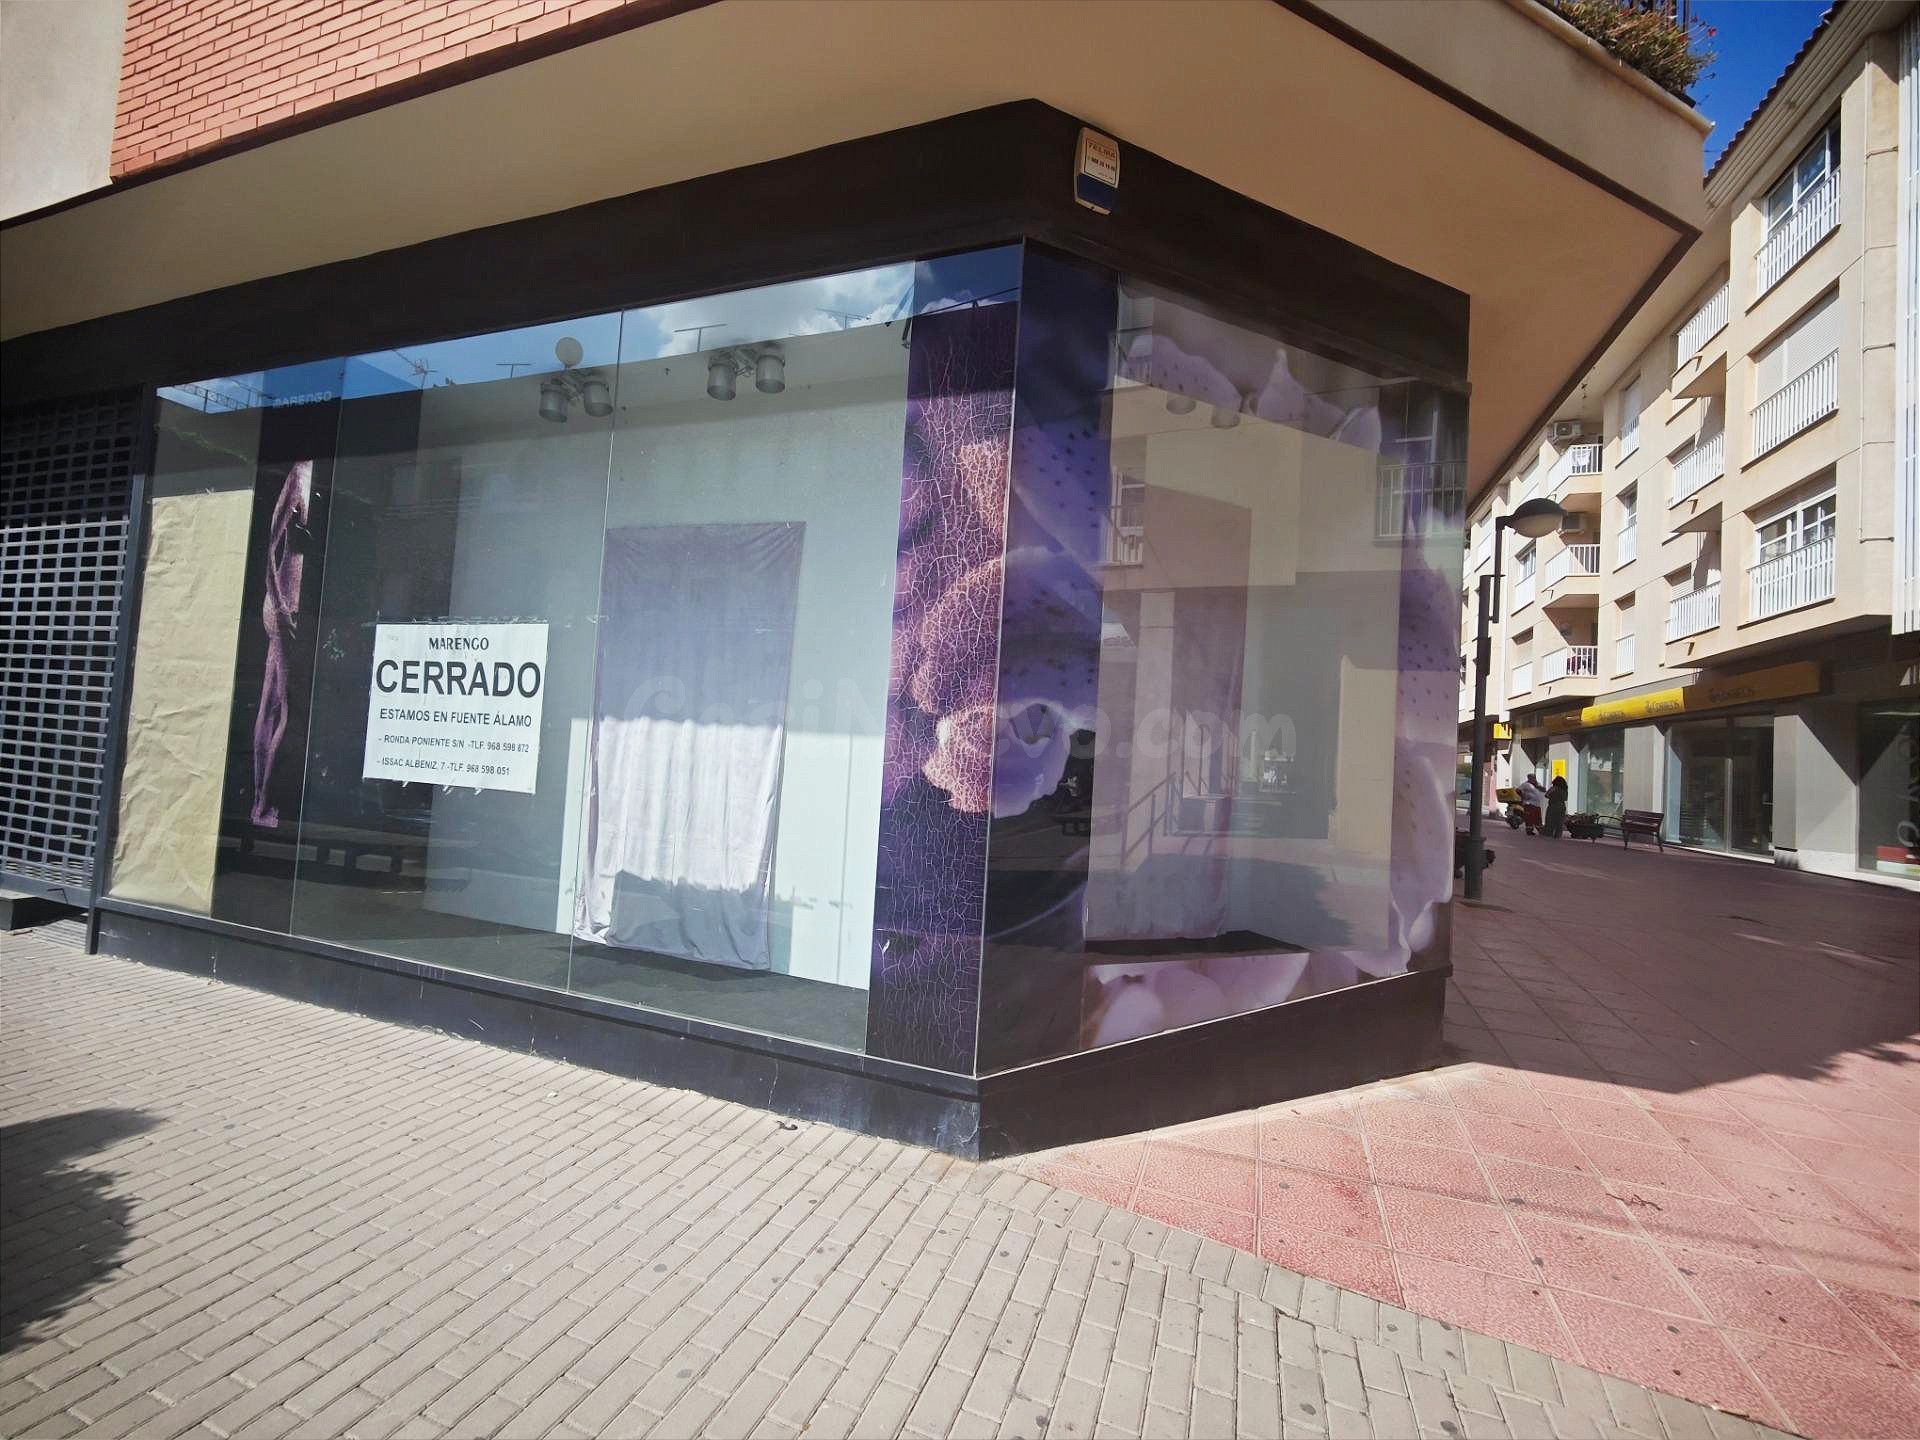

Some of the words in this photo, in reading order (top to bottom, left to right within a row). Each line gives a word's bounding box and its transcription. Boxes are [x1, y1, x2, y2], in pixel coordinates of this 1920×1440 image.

[428, 637, 490, 651] MARENGO
[375, 659, 541, 699] CERRADO
[380, 708, 430, 722] ESTAMOS
[433, 711, 448, 723] EN
[450, 711, 490, 725] FUENTE
[493, 710, 532, 727] ÁLAMO
[383, 734, 411, 745] RONDA
[411, 736, 451, 748] PONIENTE
[487, 741, 501, 751] 968
[502, 742, 516, 752] 598
[382, 756, 404, 768] ISSAC
[440, 761, 446, 770] 7
[481, 765, 495, 775] 598
